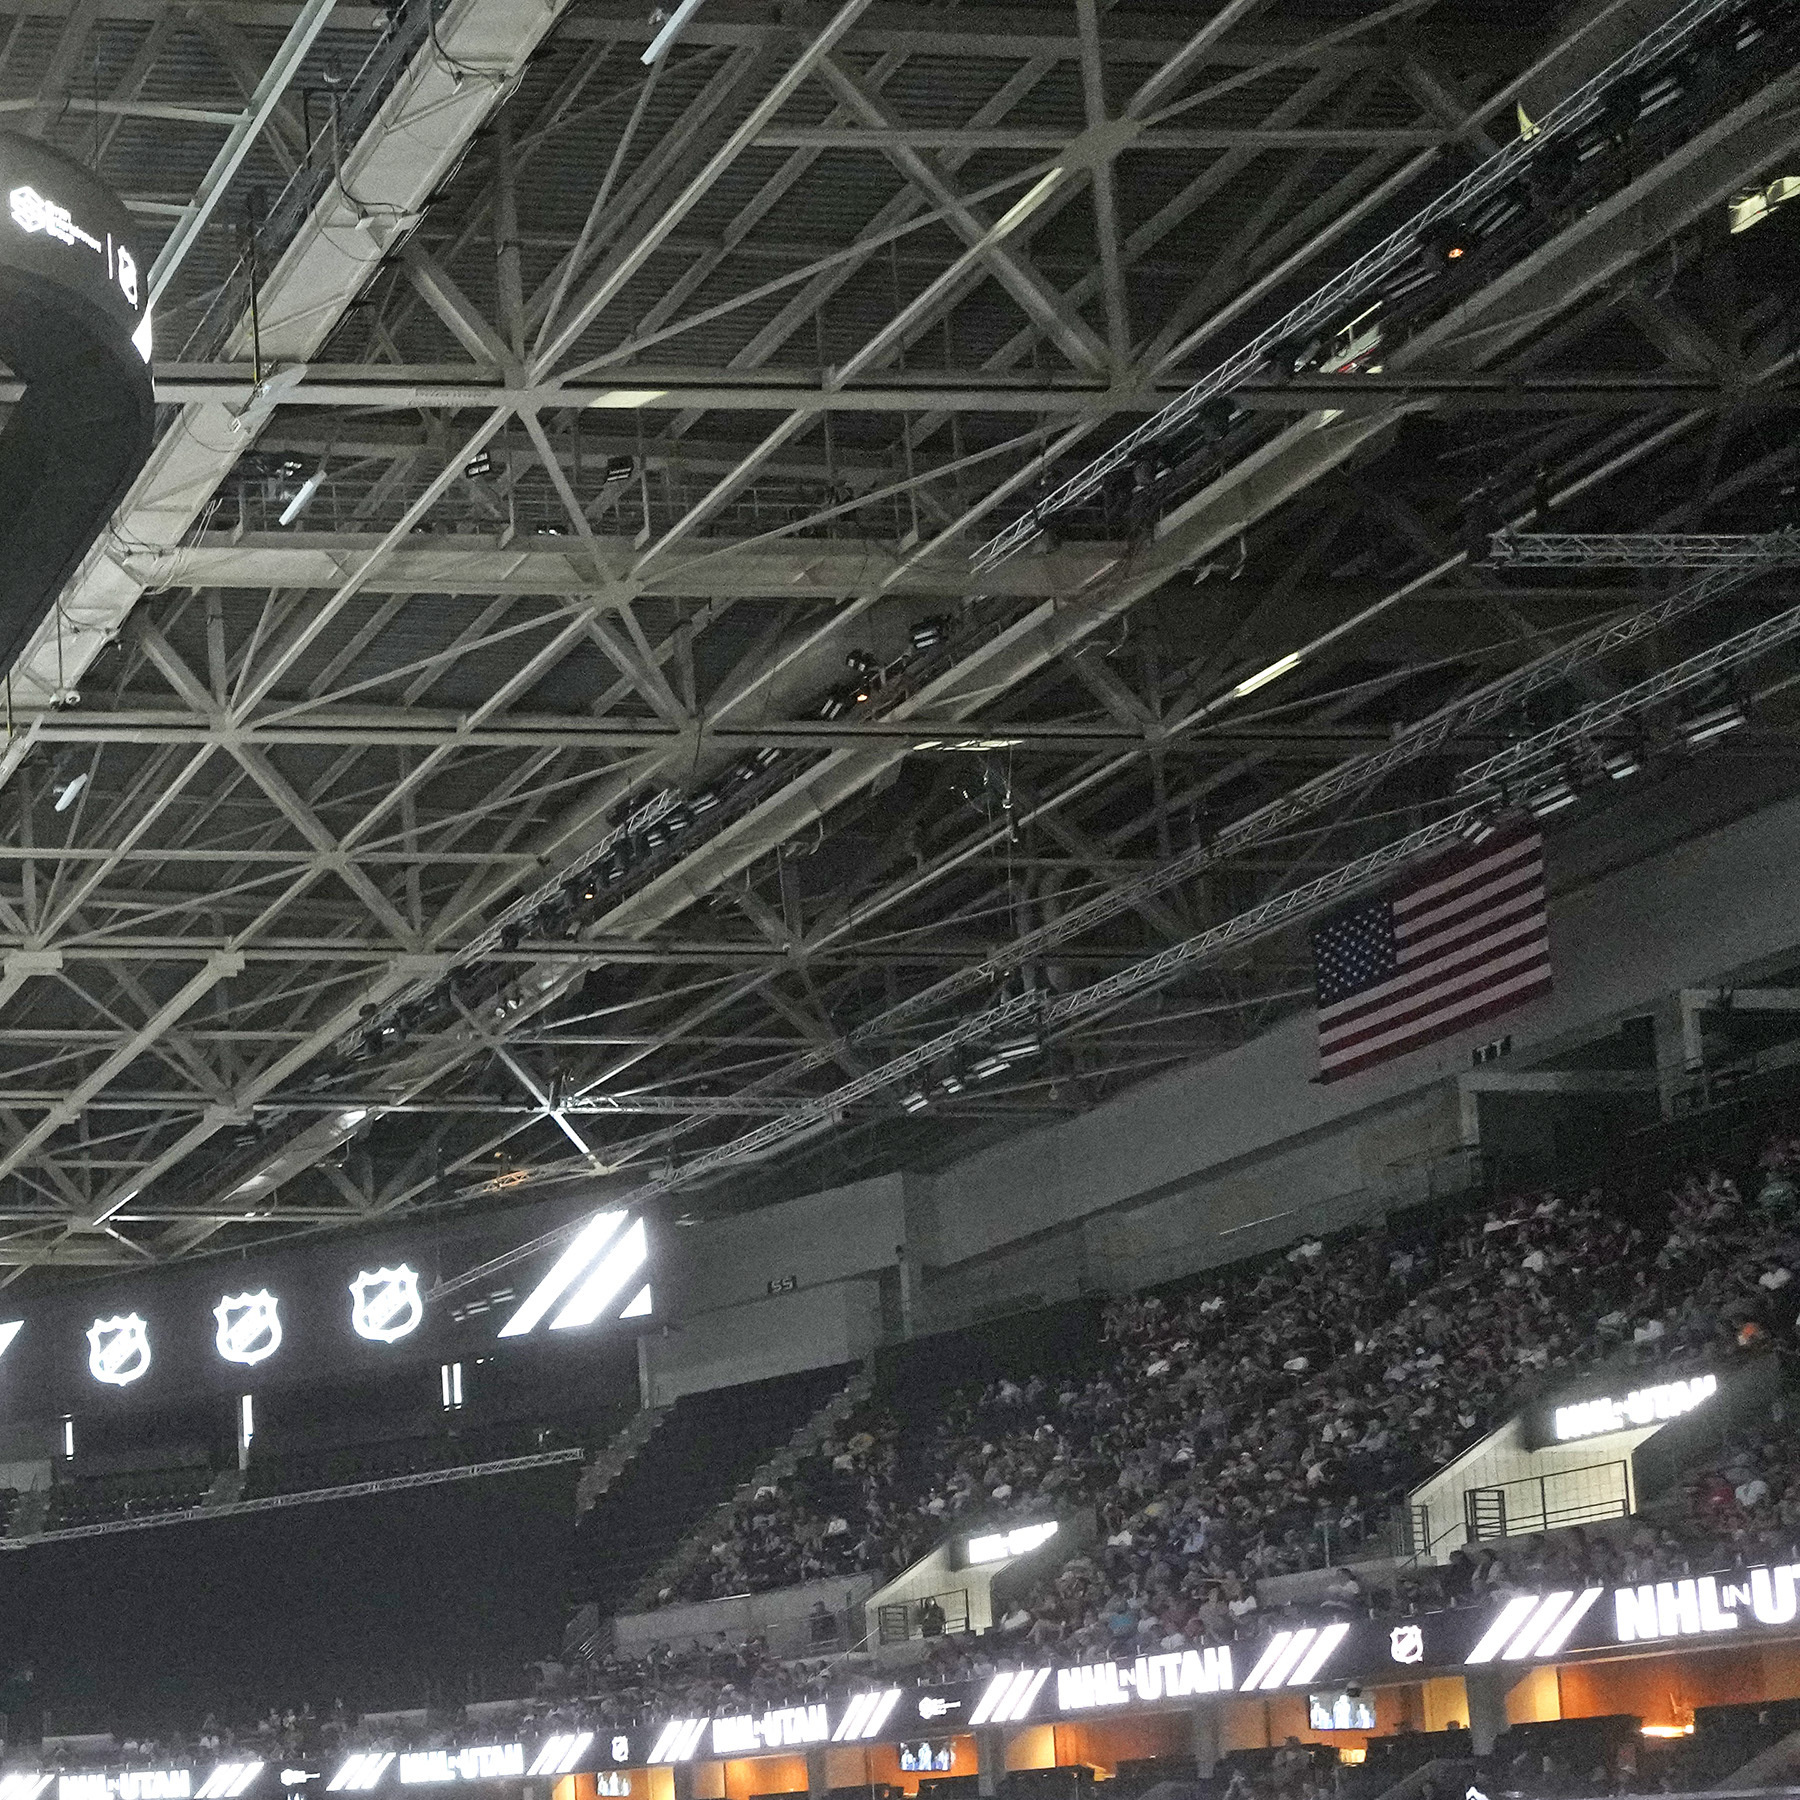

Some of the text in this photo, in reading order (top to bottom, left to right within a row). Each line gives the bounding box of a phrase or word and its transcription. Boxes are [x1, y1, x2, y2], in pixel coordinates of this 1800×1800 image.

[1614, 1577, 1738, 1642] NHL
[1723, 1583, 1751, 1608] IN
[1057, 1662, 1129, 1710] NHL
[1135, 1645, 1233, 1700] UTAH
[120, 1769, 190, 1800] UTAH
[460, 1743, 524, 1779] UTAH
